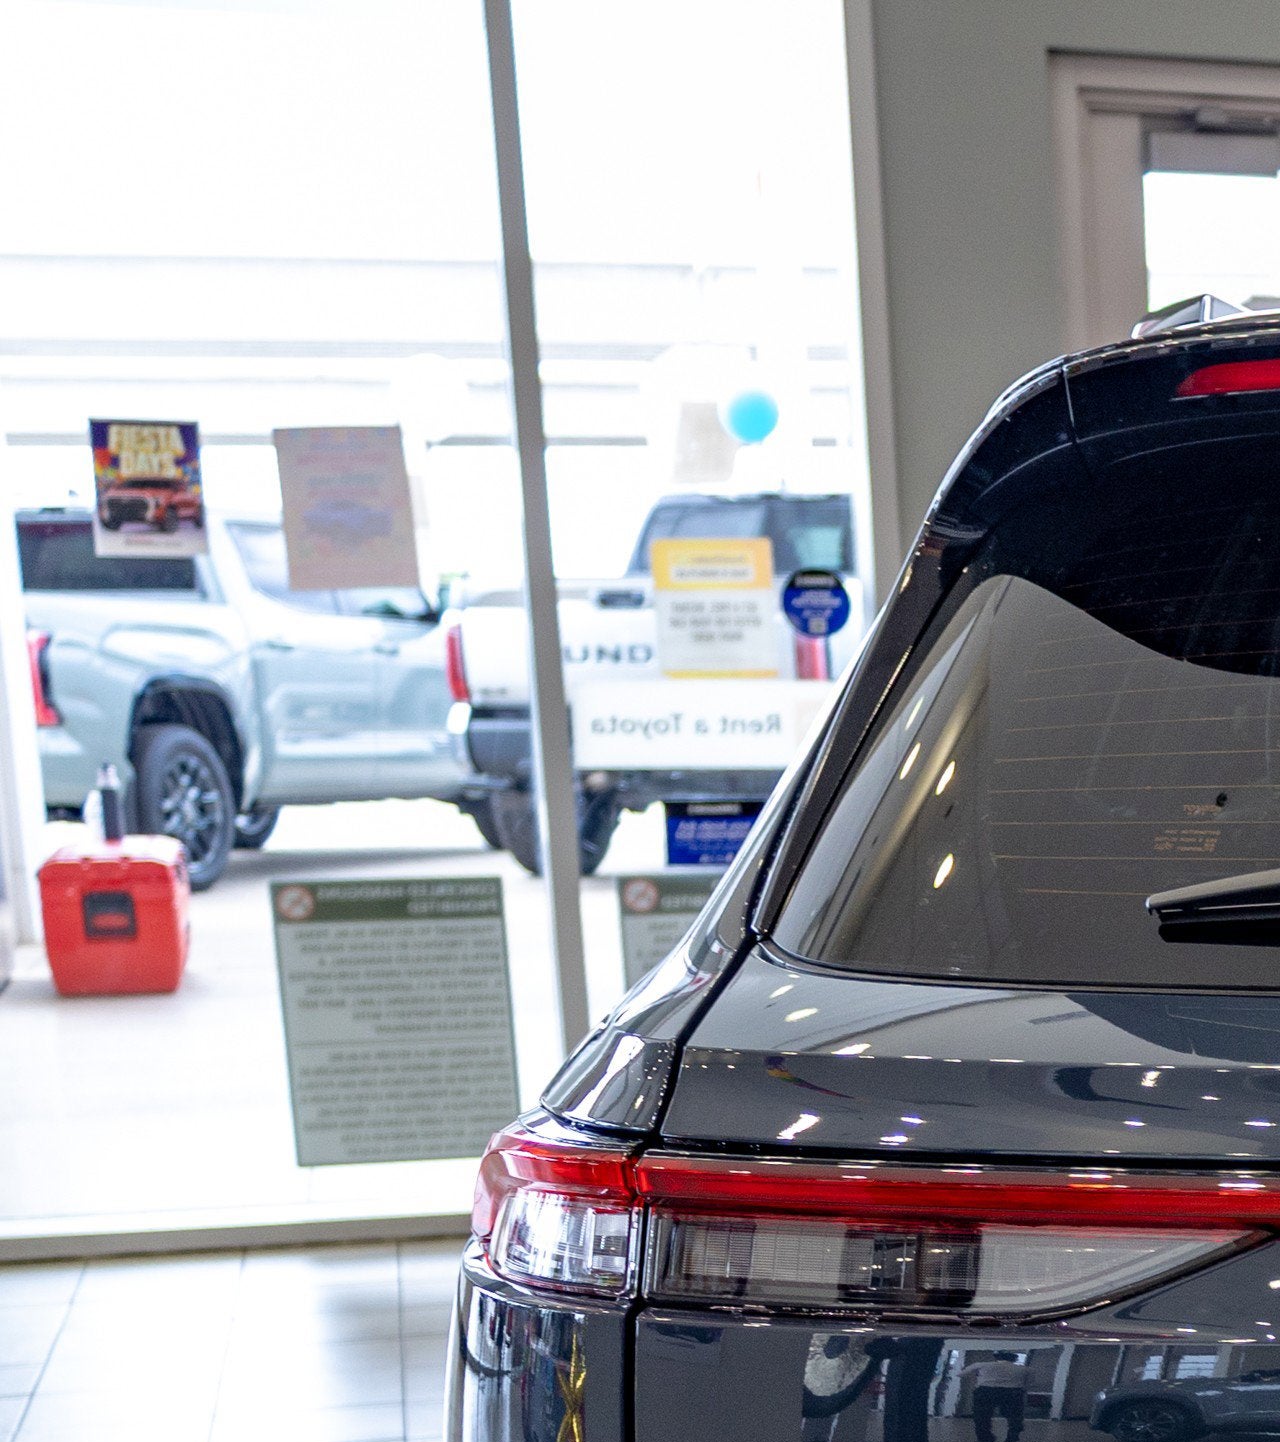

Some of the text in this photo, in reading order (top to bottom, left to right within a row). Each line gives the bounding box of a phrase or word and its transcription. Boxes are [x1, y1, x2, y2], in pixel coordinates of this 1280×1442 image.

[108, 425, 185, 455] FIESTA
[119, 452, 178, 478] DAYS
[563, 643, 653, 664] UND
